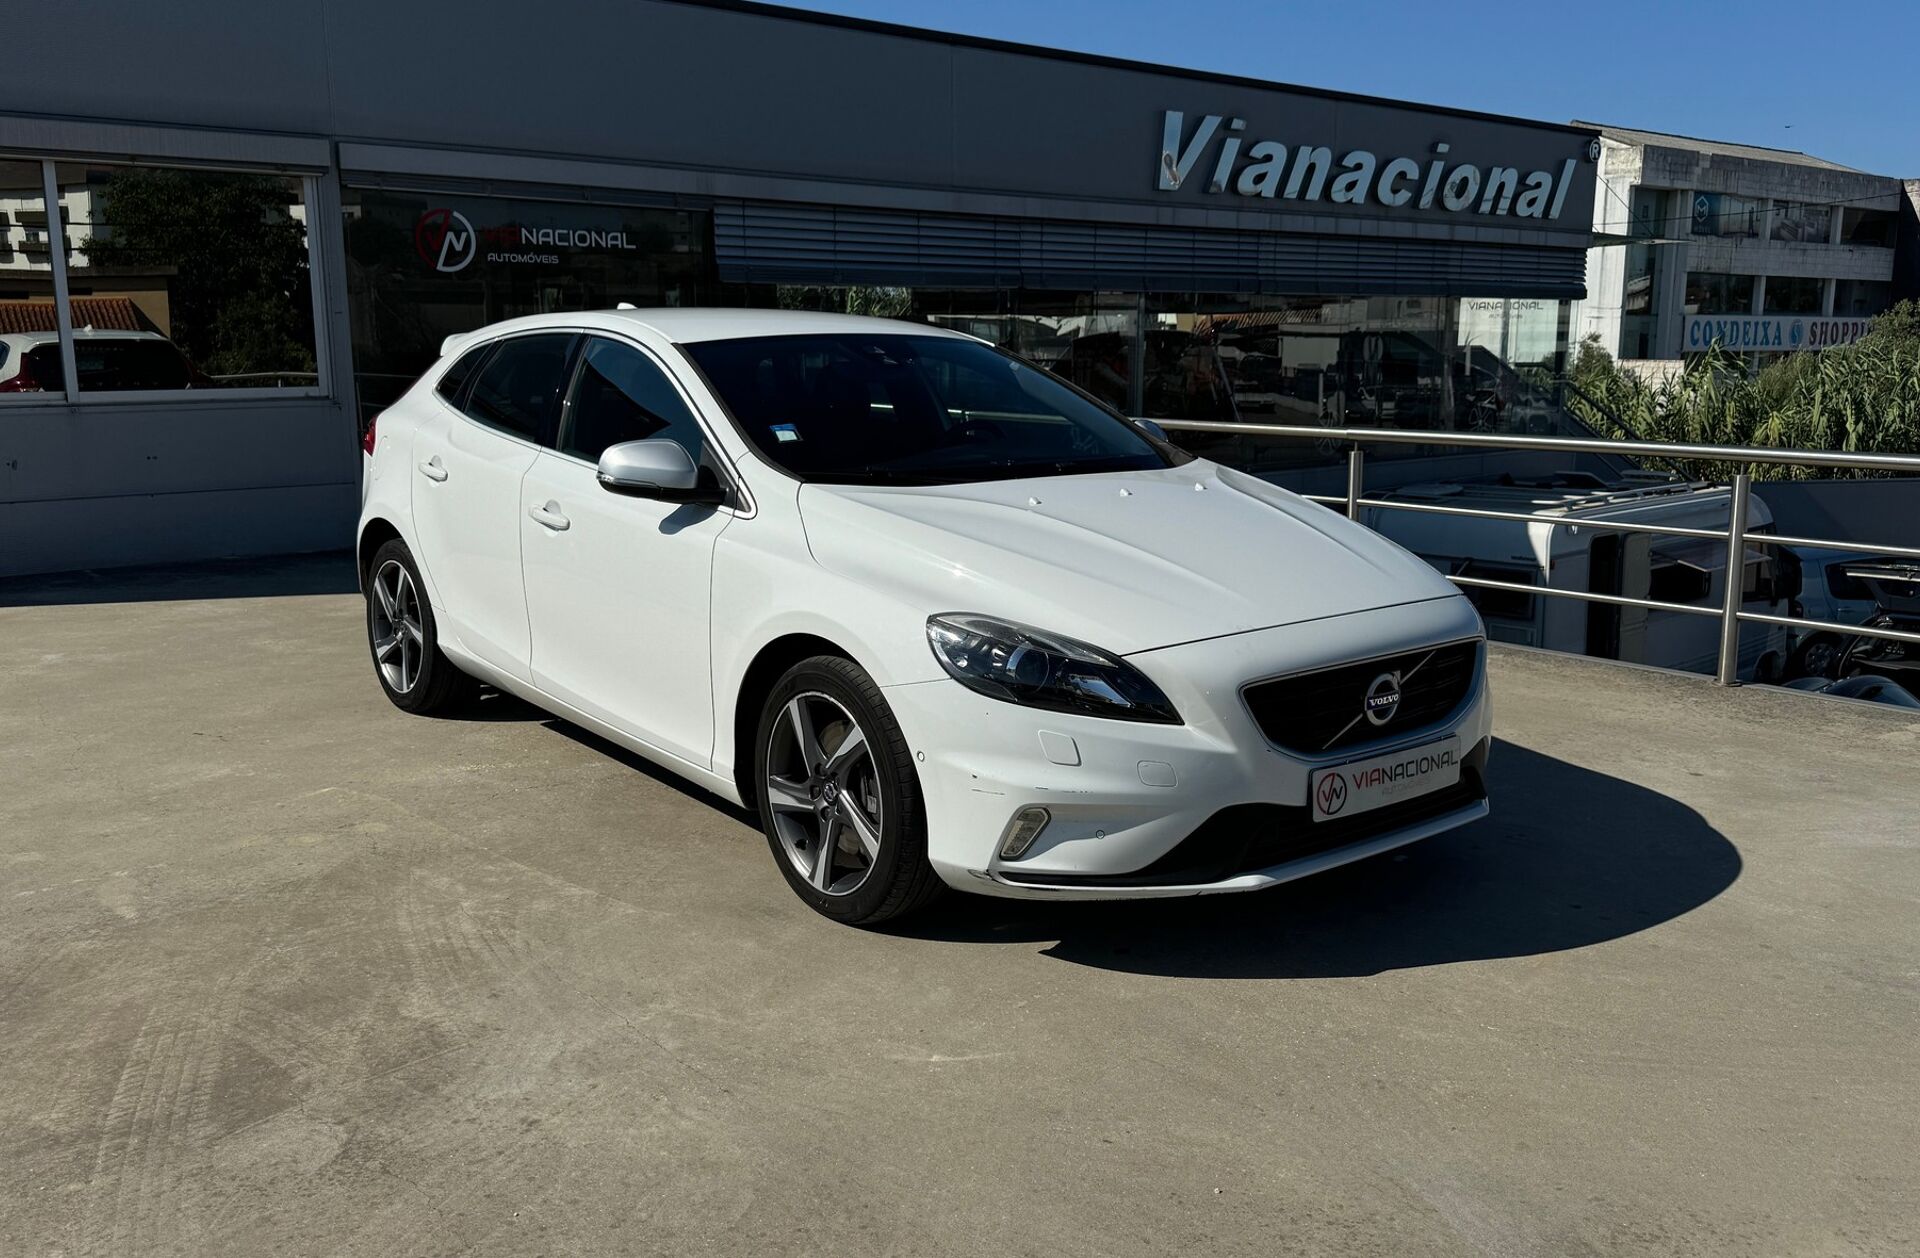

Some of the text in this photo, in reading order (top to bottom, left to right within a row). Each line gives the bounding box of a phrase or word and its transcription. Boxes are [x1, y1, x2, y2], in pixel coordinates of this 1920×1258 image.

[1156, 110, 1576, 220] Vianacional
[488, 252, 559, 265] AUTOMÓVEIS
[1468, 301, 1544, 310] VIANAIONAL
[1690, 319, 1782, 346] CONDEIXA
[1369, 694, 1399, 706] VOLVO
[1352, 751, 1458, 789] VIANACIONAL
